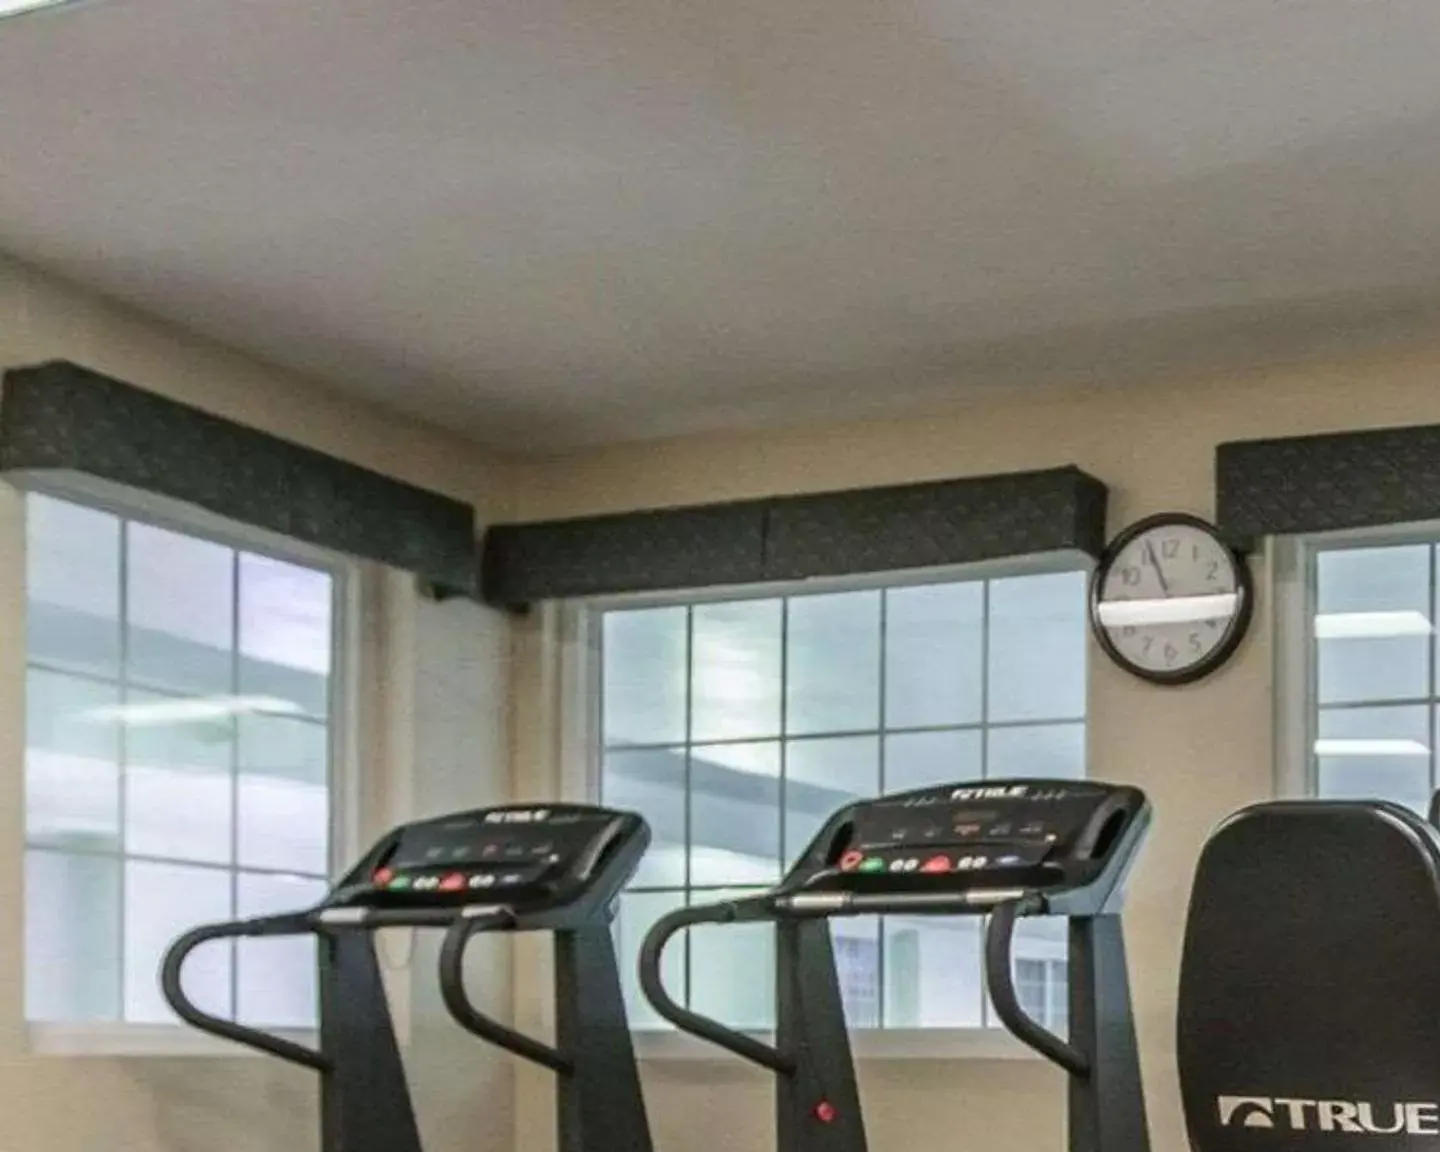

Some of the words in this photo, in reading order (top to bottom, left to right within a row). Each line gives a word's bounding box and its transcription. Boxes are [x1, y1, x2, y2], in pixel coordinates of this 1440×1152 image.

[1161, 538, 1180, 559] 12
[1191, 544, 1199, 562] 1
[1121, 566, 1142, 586] 10
[1205, 561, 1219, 580] 2
[1274, 1097, 1440, 1134] TRUE
